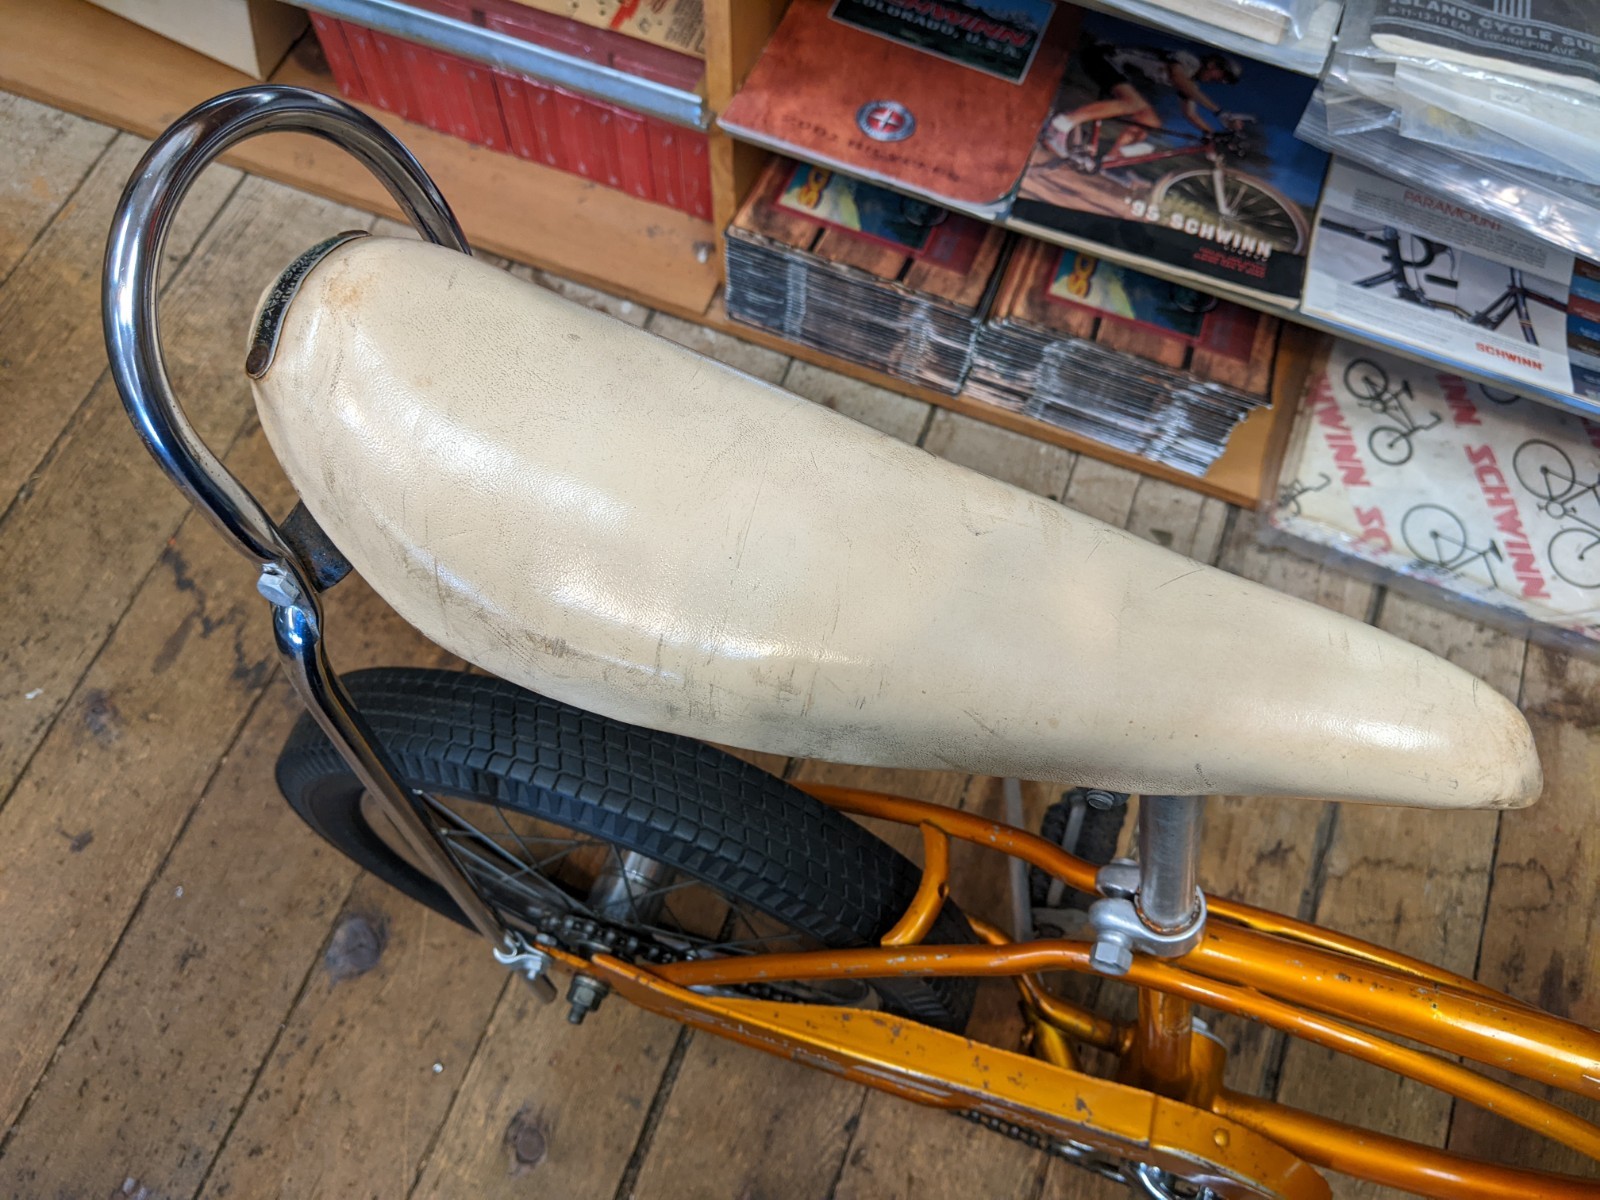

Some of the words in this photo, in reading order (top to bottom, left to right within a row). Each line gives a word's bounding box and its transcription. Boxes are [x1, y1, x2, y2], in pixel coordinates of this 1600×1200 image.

[851, 0, 960, 39] OLORADO,
[1451, 20, 1480, 38] EAST
[1478, 18, 1552, 42] CYCLE
[1170, 210, 1273, 259] SCHWINN
[1475, 342, 1543, 370] SCHWINN
[1464, 444, 1551, 599] SCHWINN
